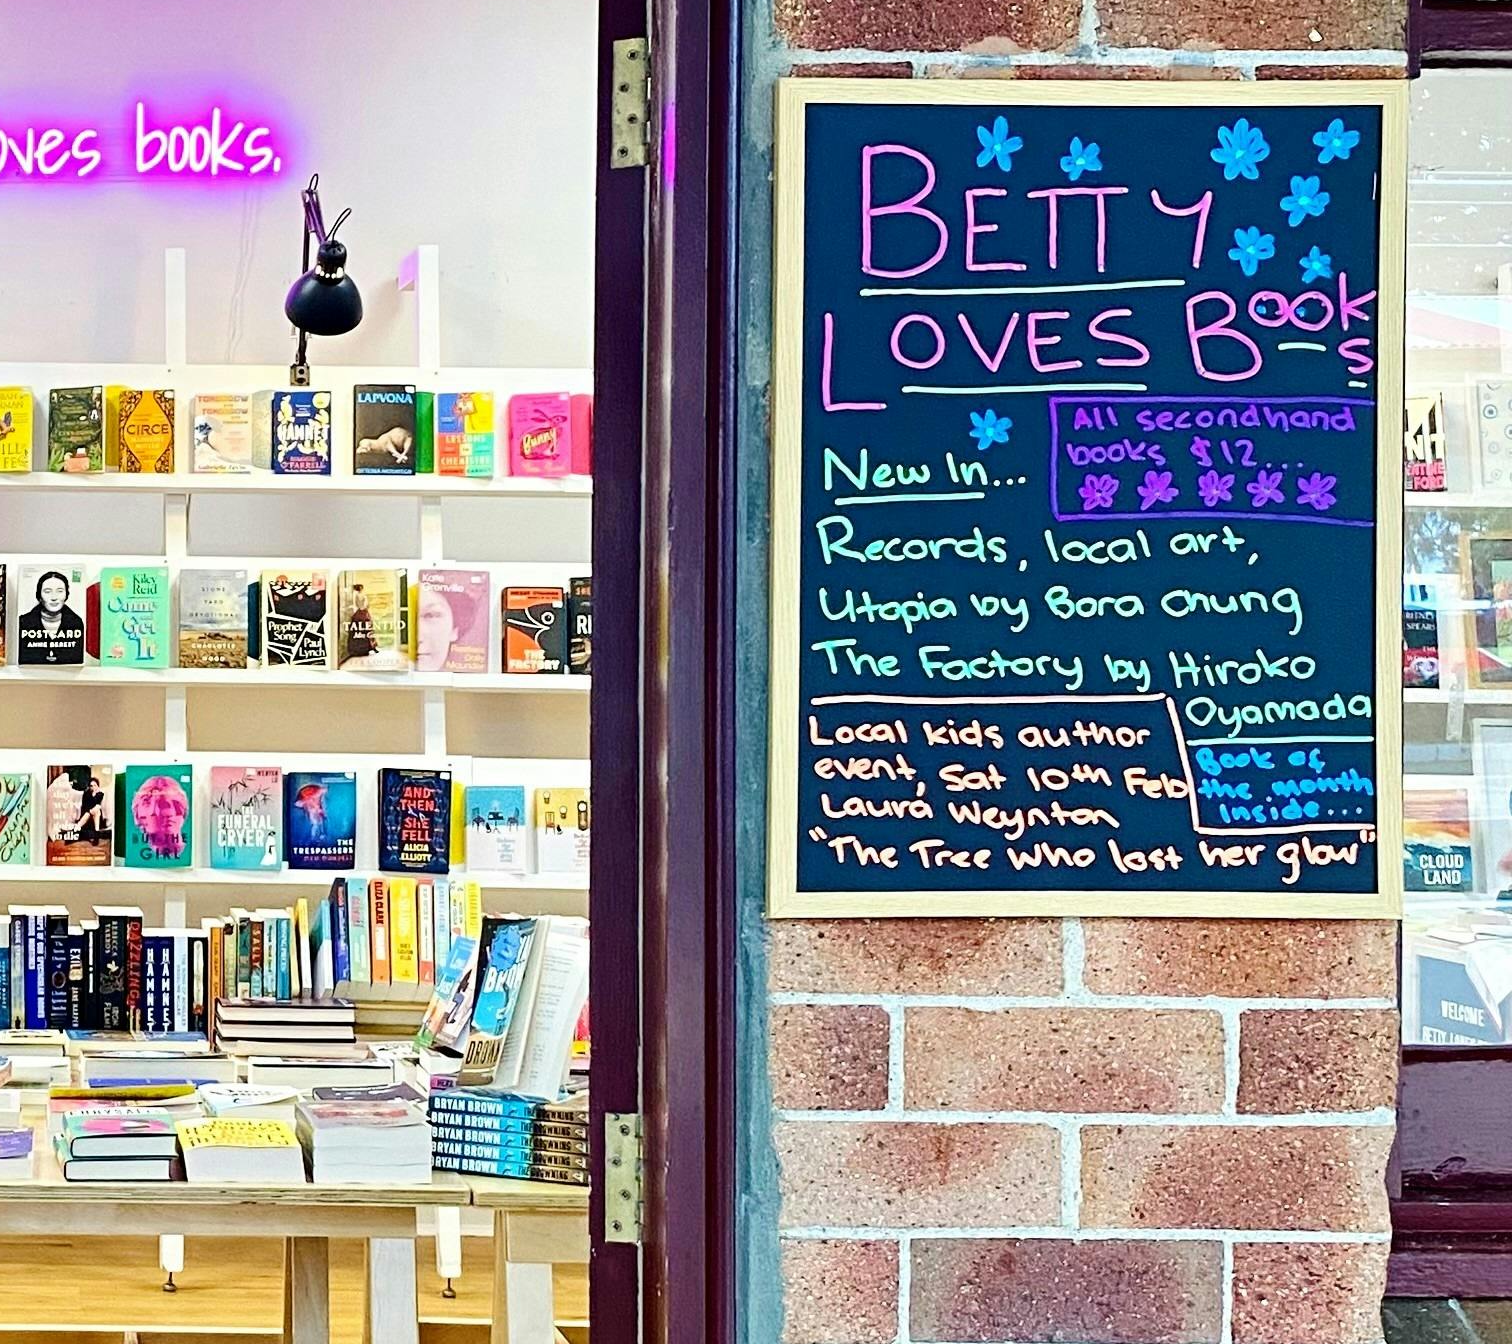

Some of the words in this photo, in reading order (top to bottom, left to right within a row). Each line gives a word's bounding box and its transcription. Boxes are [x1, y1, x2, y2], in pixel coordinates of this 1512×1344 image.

[135, 102, 282, 176] books.
[860, 143, 1215, 278] BETTY
[820, 308, 1151, 413] LOVES
[358, 392, 414, 405] LAPVONA
[1071, 406, 1128, 433] All
[1141, 404, 1357, 434] secondhand
[126, 423, 169, 436] CIRCE
[522, 427, 557, 456] Bunny
[1066, 439, 1172, 469] books
[823, 447, 931, 491] New
[1413, 476, 1444, 490] FORD
[816, 516, 1031, 573] Records,
[1045, 528, 1151, 565] local
[1169, 526, 1260, 568] art,
[819, 589, 958, 635] Utopia
[973, 589, 1030, 637] by
[1046, 587, 1145, 619] Bora
[21, 629, 82, 640] POSTCARD
[268, 620, 304, 632] Prophet
[273, 631, 298, 644] Song
[303, 637, 323, 649] Paul
[299, 644, 326, 658] Lynch
[810, 637, 901, 681] The
[916, 645, 1086, 693] Factory
[1104, 652, 1152, 694] by
[1168, 648, 1317, 689] Hiroko
[1184, 693, 1373, 739] Oyamada
[809, 713, 909, 747] Local
[922, 717, 1004, 750] kids
[1017, 719, 1152, 749] author
[1195, 746, 1276, 776] Book
[1287, 746, 1326, 773] of
[812, 755, 926, 798] event,
[937, 764, 1008, 793] Sat
[1022, 761, 1114, 793] 10th
[1123, 767, 1191, 801] Feb
[1197, 778, 1253, 799] the
[1270, 767, 1374, 797] month
[403, 786, 431, 799] AND
[399, 799, 435, 813] THEN
[217, 814, 275, 830] FUNERAL
[403, 817, 430, 830] SHE
[818, 792, 934, 821] Laura
[948, 800, 1120, 840] Weynton
[217, 829, 265, 847] CRYER
[337, 838, 354, 846] THE
[400, 829, 432, 842] FELL
[139, 847, 181, 860] GIRL
[293, 846, 354, 855] TRESPASSERS
[402, 842, 430, 853] ALICIA
[916, 832, 991, 870] Tree
[1109, 839, 1184, 873] lost
[1198, 839, 1266, 868] her
[1419, 853, 1465, 871] CLOUD
[1423, 869, 1463, 886] LAND
[145, 947, 157, 1035] HAMNET
[161, 947, 172, 1036] HAMNET
[1440, 999, 1486, 1028] WELCOME
[434, 1096, 466, 1112] BRYAN
[467, 1099, 504, 1114] BROWN
[431, 1111, 464, 1127] BRYAN
[464, 1114, 501, 1130] BROWN
[432, 1126, 464, 1141] BRYAN
[464, 1129, 501, 1144] BROWN
[463, 1144, 500, 1160] BROWN
[461, 1159, 498, 1174] BROWN
